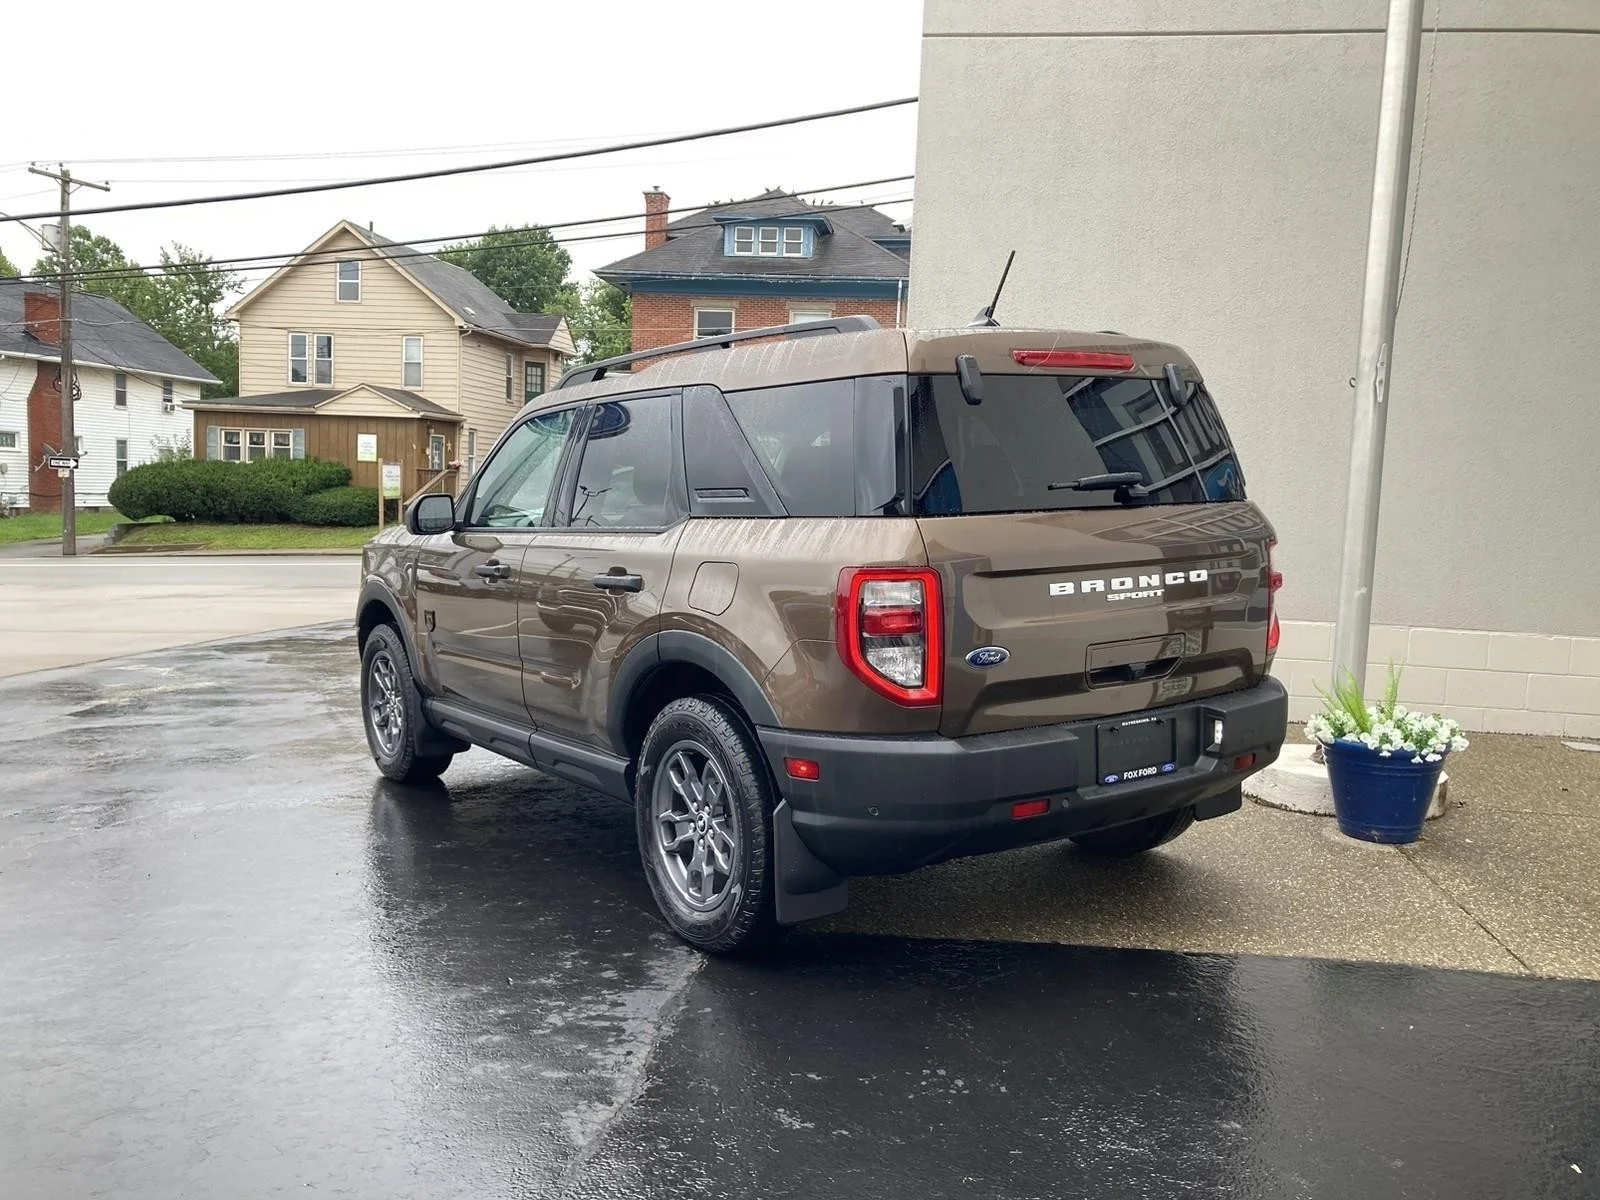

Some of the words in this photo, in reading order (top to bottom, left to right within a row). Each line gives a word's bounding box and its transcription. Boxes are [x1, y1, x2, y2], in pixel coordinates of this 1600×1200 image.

[1049, 569, 1208, 596] BRONCO
[1106, 588, 1165, 602] SPORT
[976, 651, 1001, 664] Ford
[1123, 769, 1138, 780] FOX
[1138, 766, 1157, 777] FORD
